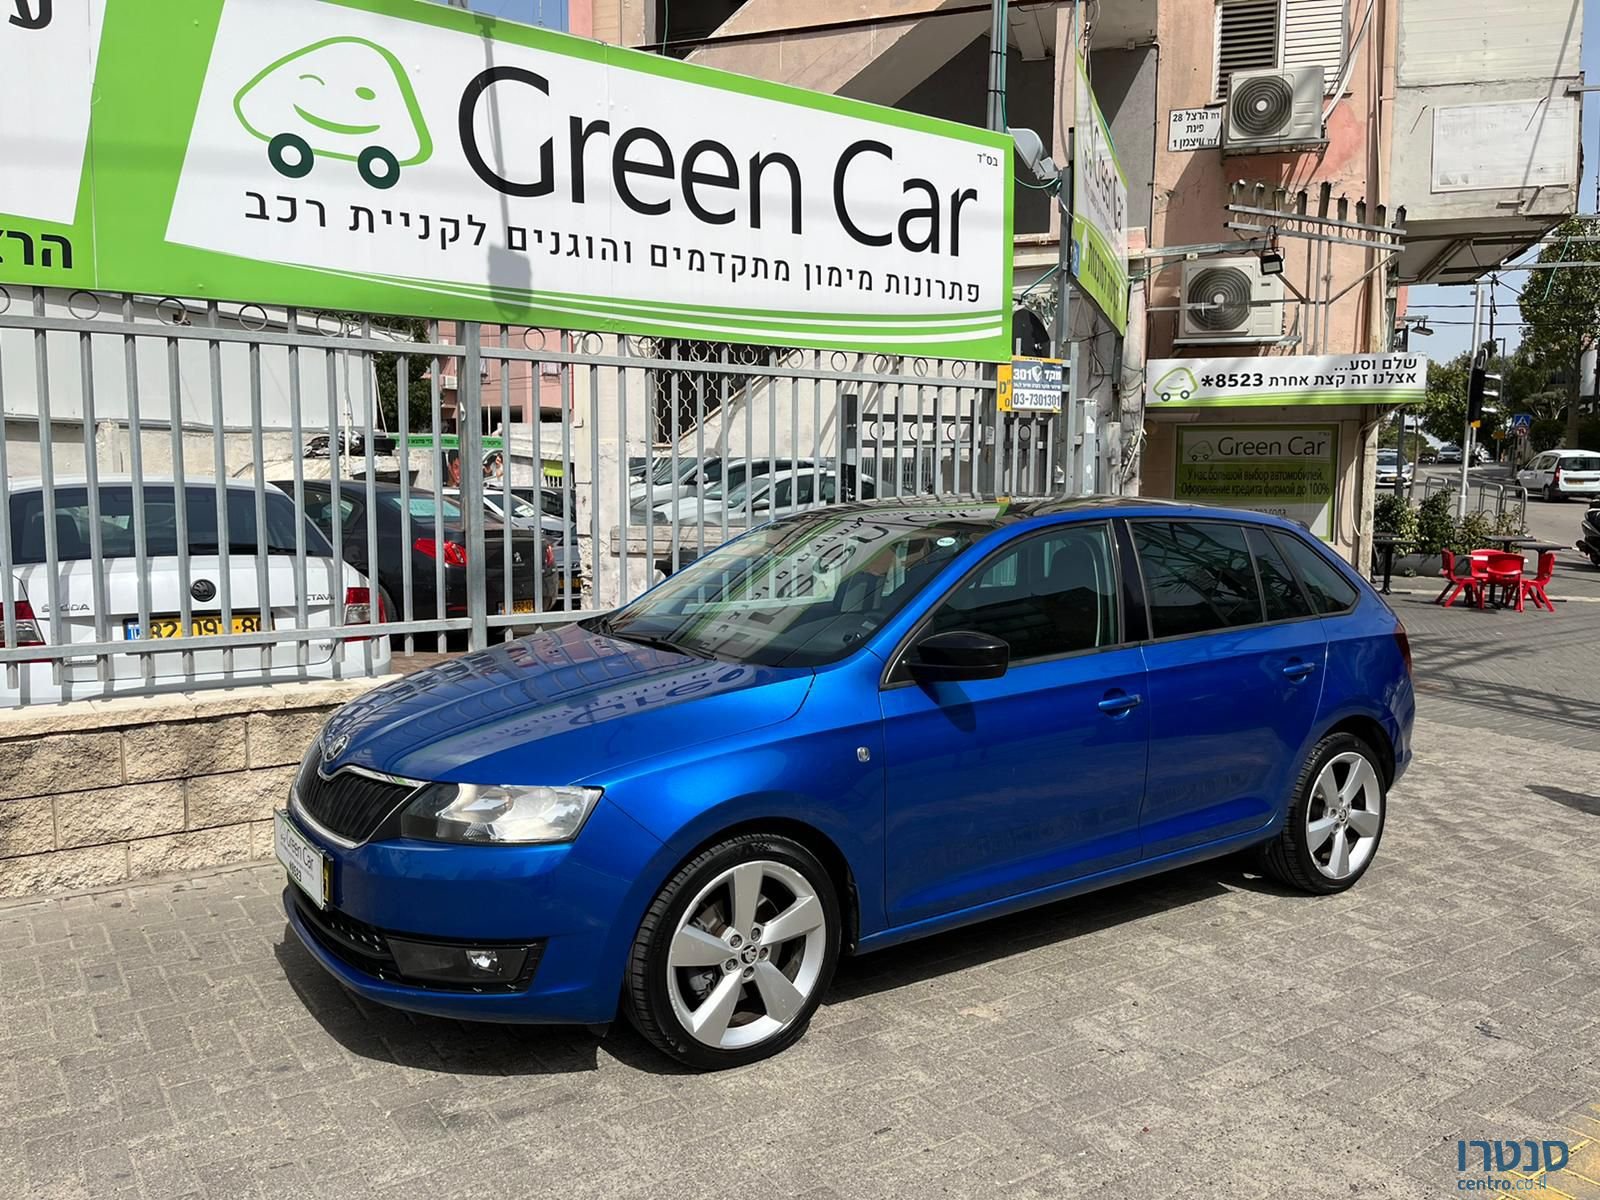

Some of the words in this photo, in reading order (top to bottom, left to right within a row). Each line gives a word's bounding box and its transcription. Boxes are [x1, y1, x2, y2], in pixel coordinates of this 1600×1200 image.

[1172, 113, 1183, 122] 28
[1185, 111, 1208, 121] הרצל
[1185, 124, 1205, 133] פינת
[1173, 139, 1177, 147] 1
[459, 66, 803, 235] Green
[833, 139, 979, 257] Car
[244, 191, 327, 228] רכב
[349, 205, 487, 250] לקניית
[507, 225, 631, 264] והוגנים
[650, 244, 791, 283] מתקדמים
[804, 263, 873, 291] מימון
[885, 273, 980, 303] פתרונות
[1334, 360, 1377, 371] וסע...
[1382, 357, 1417, 370] שלם
[1013, 368, 1032, 381] 301
[1268, 376, 1310, 387] אחרת
[1313, 374, 1346, 388] קצת
[1351, 374, 1369, 385] זה
[1372, 371, 1417, 385] אצלנו
[1013, 393, 1061, 407] 03-7301301
[1217, 436, 1282, 456] Green
[1287, 436, 1326, 456] Car
[1309, 482, 1330, 496] 100%
